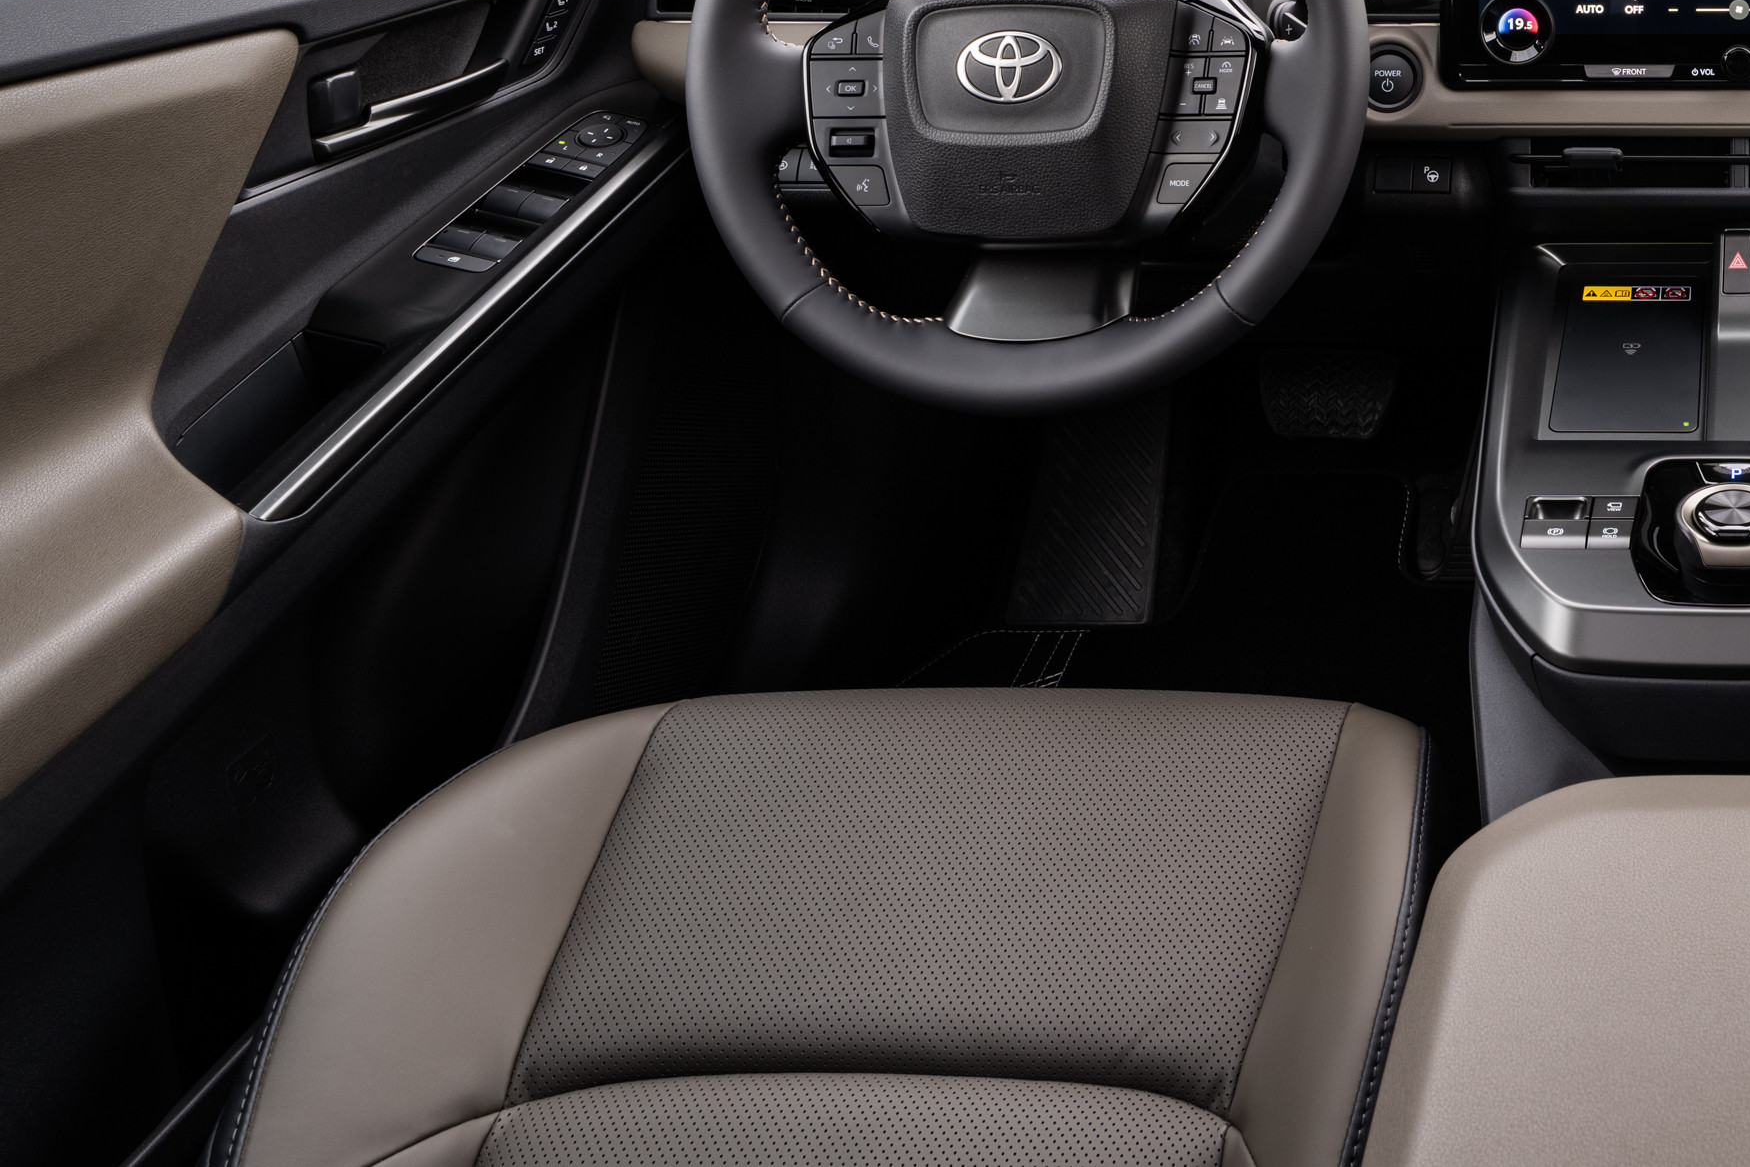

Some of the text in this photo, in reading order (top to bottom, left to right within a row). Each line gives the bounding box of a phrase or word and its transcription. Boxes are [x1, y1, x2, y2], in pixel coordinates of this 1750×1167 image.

[1575, 4, 1605, 15] AUTO
[1624, 4, 1644, 15] OFF
[1507, 17, 1534, 31] 19.5
[533, 46, 546, 57] SET
[1374, 69, 1402, 77] POWER
[1622, 67, 1646, 76] FRONT
[1700, 67, 1715, 76] VOL
[1169, 179, 1190, 187] MODE
[1730, 468, 1743, 480] P
